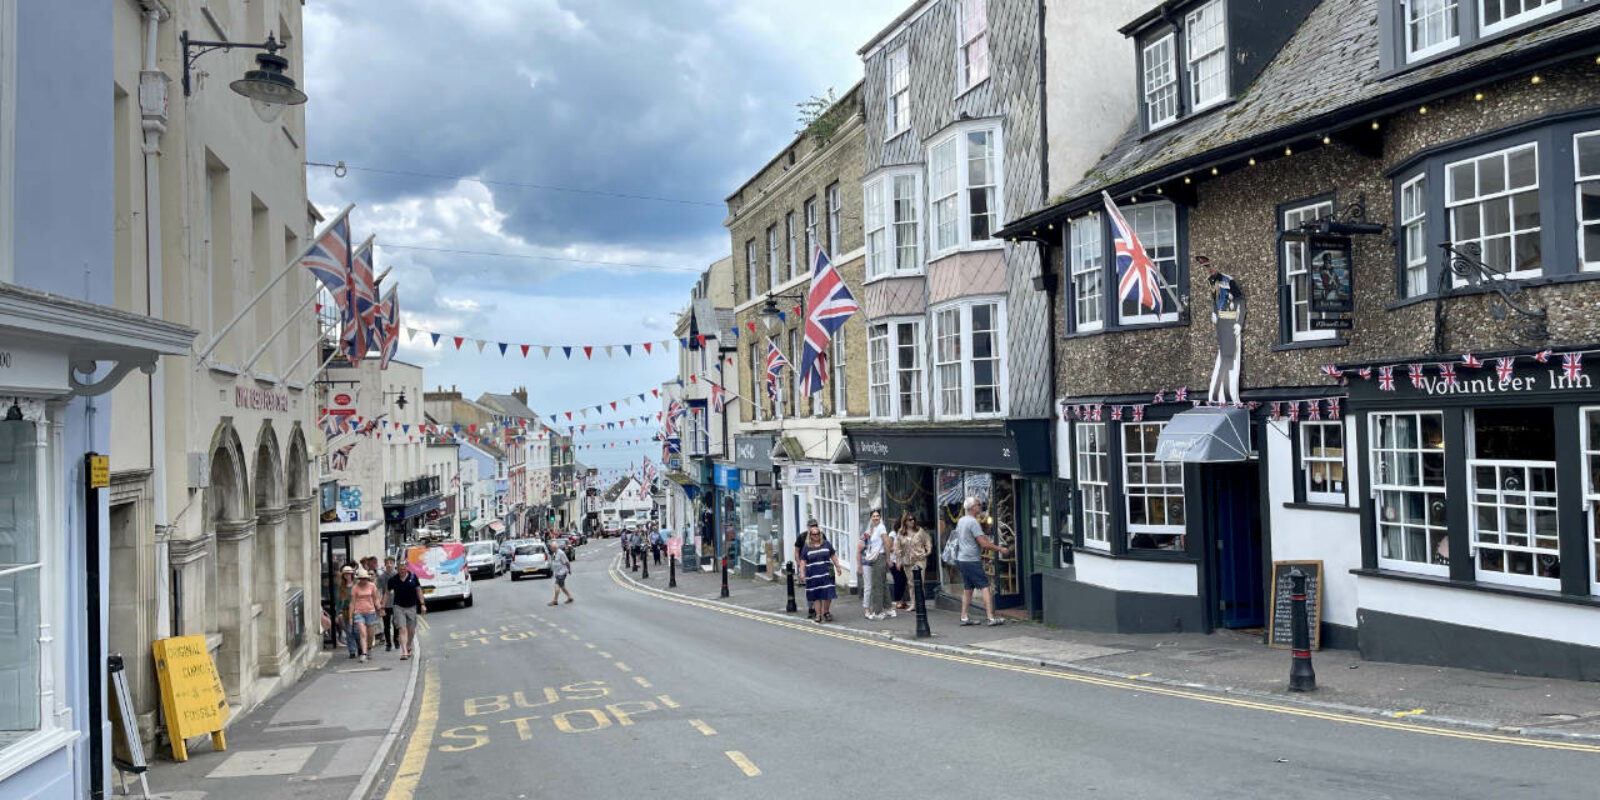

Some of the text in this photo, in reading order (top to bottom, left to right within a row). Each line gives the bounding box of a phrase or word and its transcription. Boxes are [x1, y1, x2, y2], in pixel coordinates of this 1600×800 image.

[1548, 370, 1593, 389] Inn
[464, 680, 610, 717] BUS
[438, 700, 659, 752] STOP
